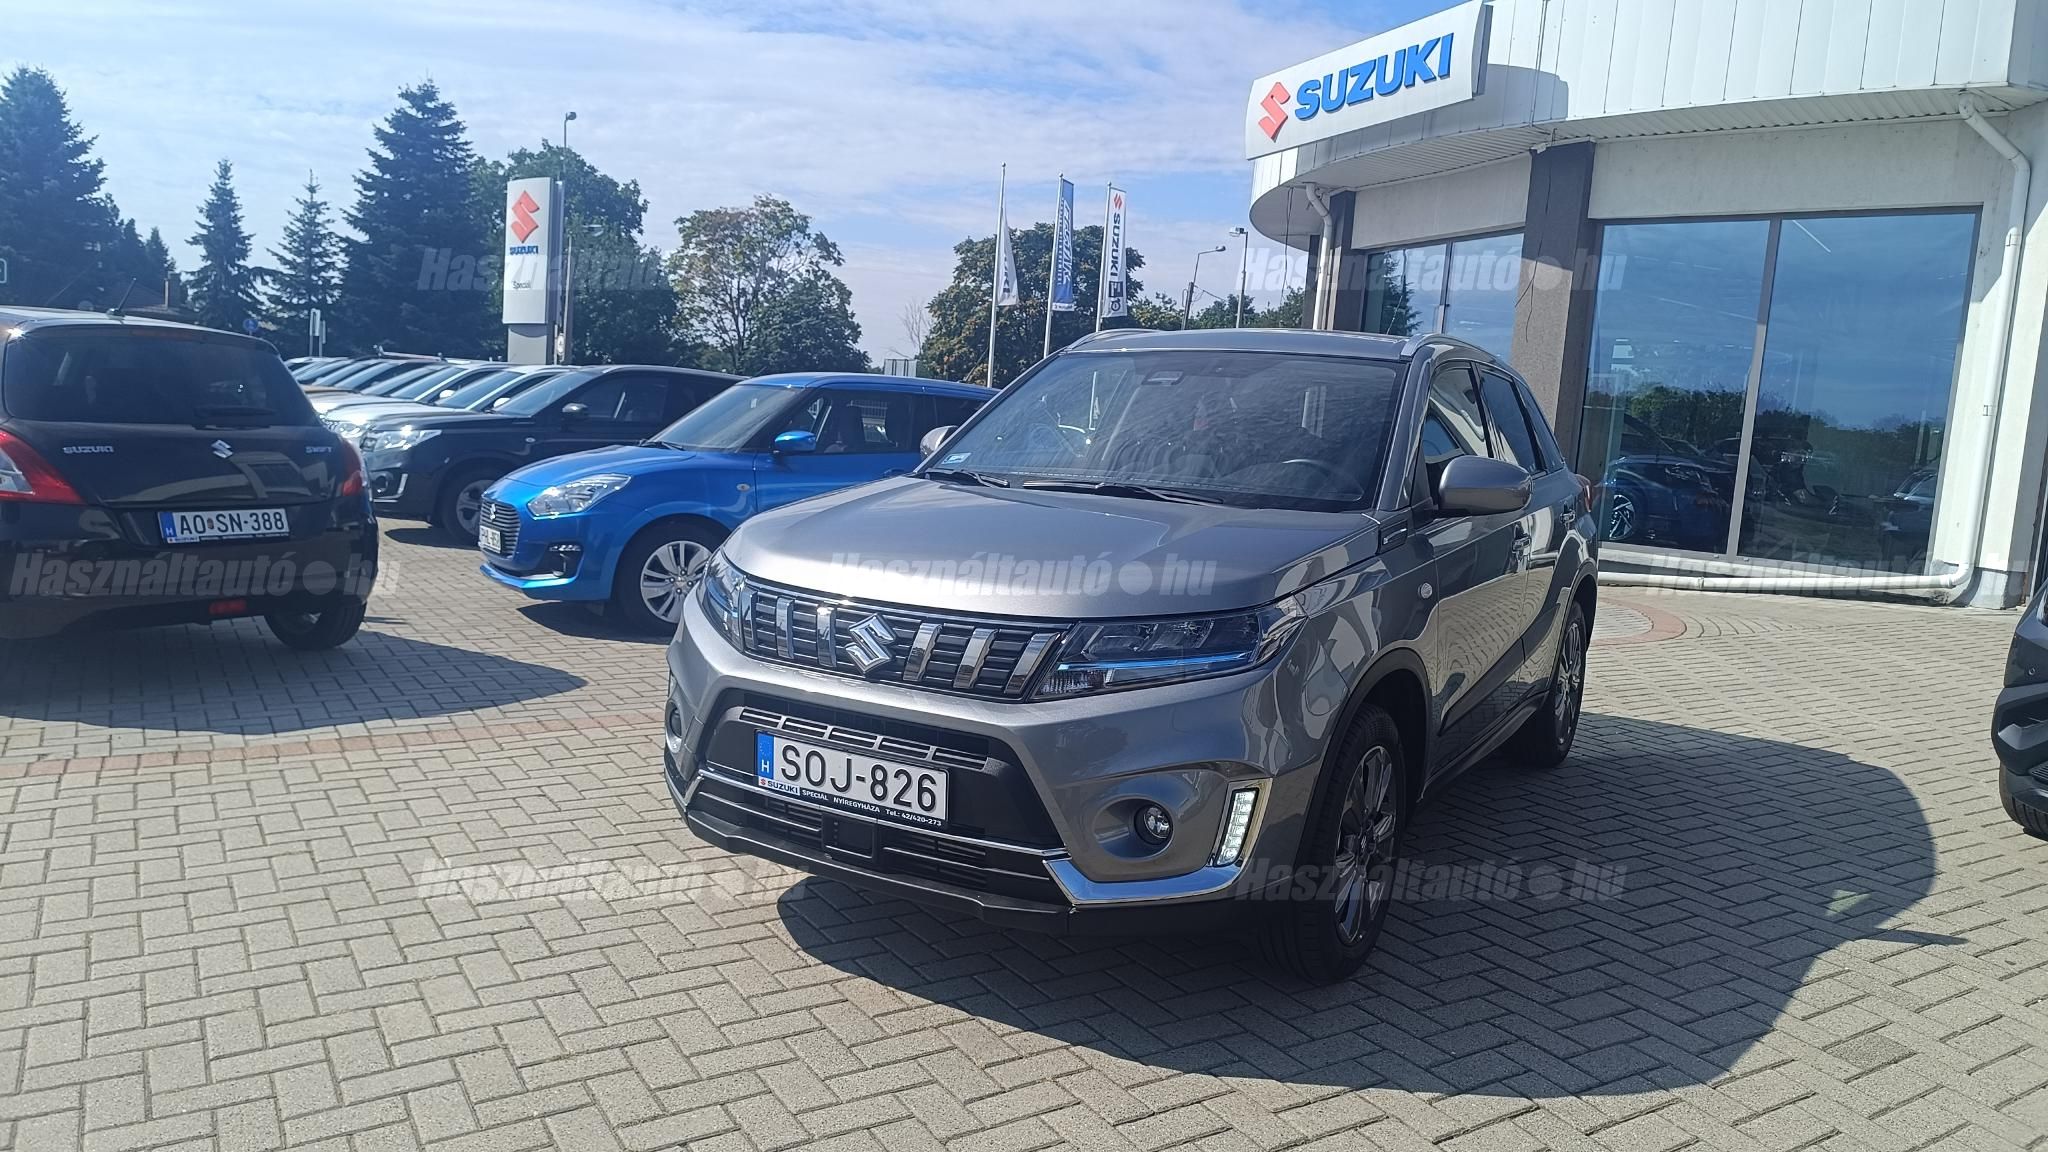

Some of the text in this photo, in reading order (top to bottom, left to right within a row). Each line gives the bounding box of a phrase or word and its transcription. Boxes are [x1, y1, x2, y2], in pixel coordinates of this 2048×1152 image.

[1295, 32, 1454, 121] SUZUKI
[509, 245, 539, 255] SUZUKI
[1110, 213, 1121, 277] SUZUKI
[63, 445, 115, 454] SUZUKI
[165, 527, 174, 536] H
[761, 759, 770, 773] H
[781, 744, 936, 812] SOJ-826
[767, 780, 799, 794] SUZUKI
